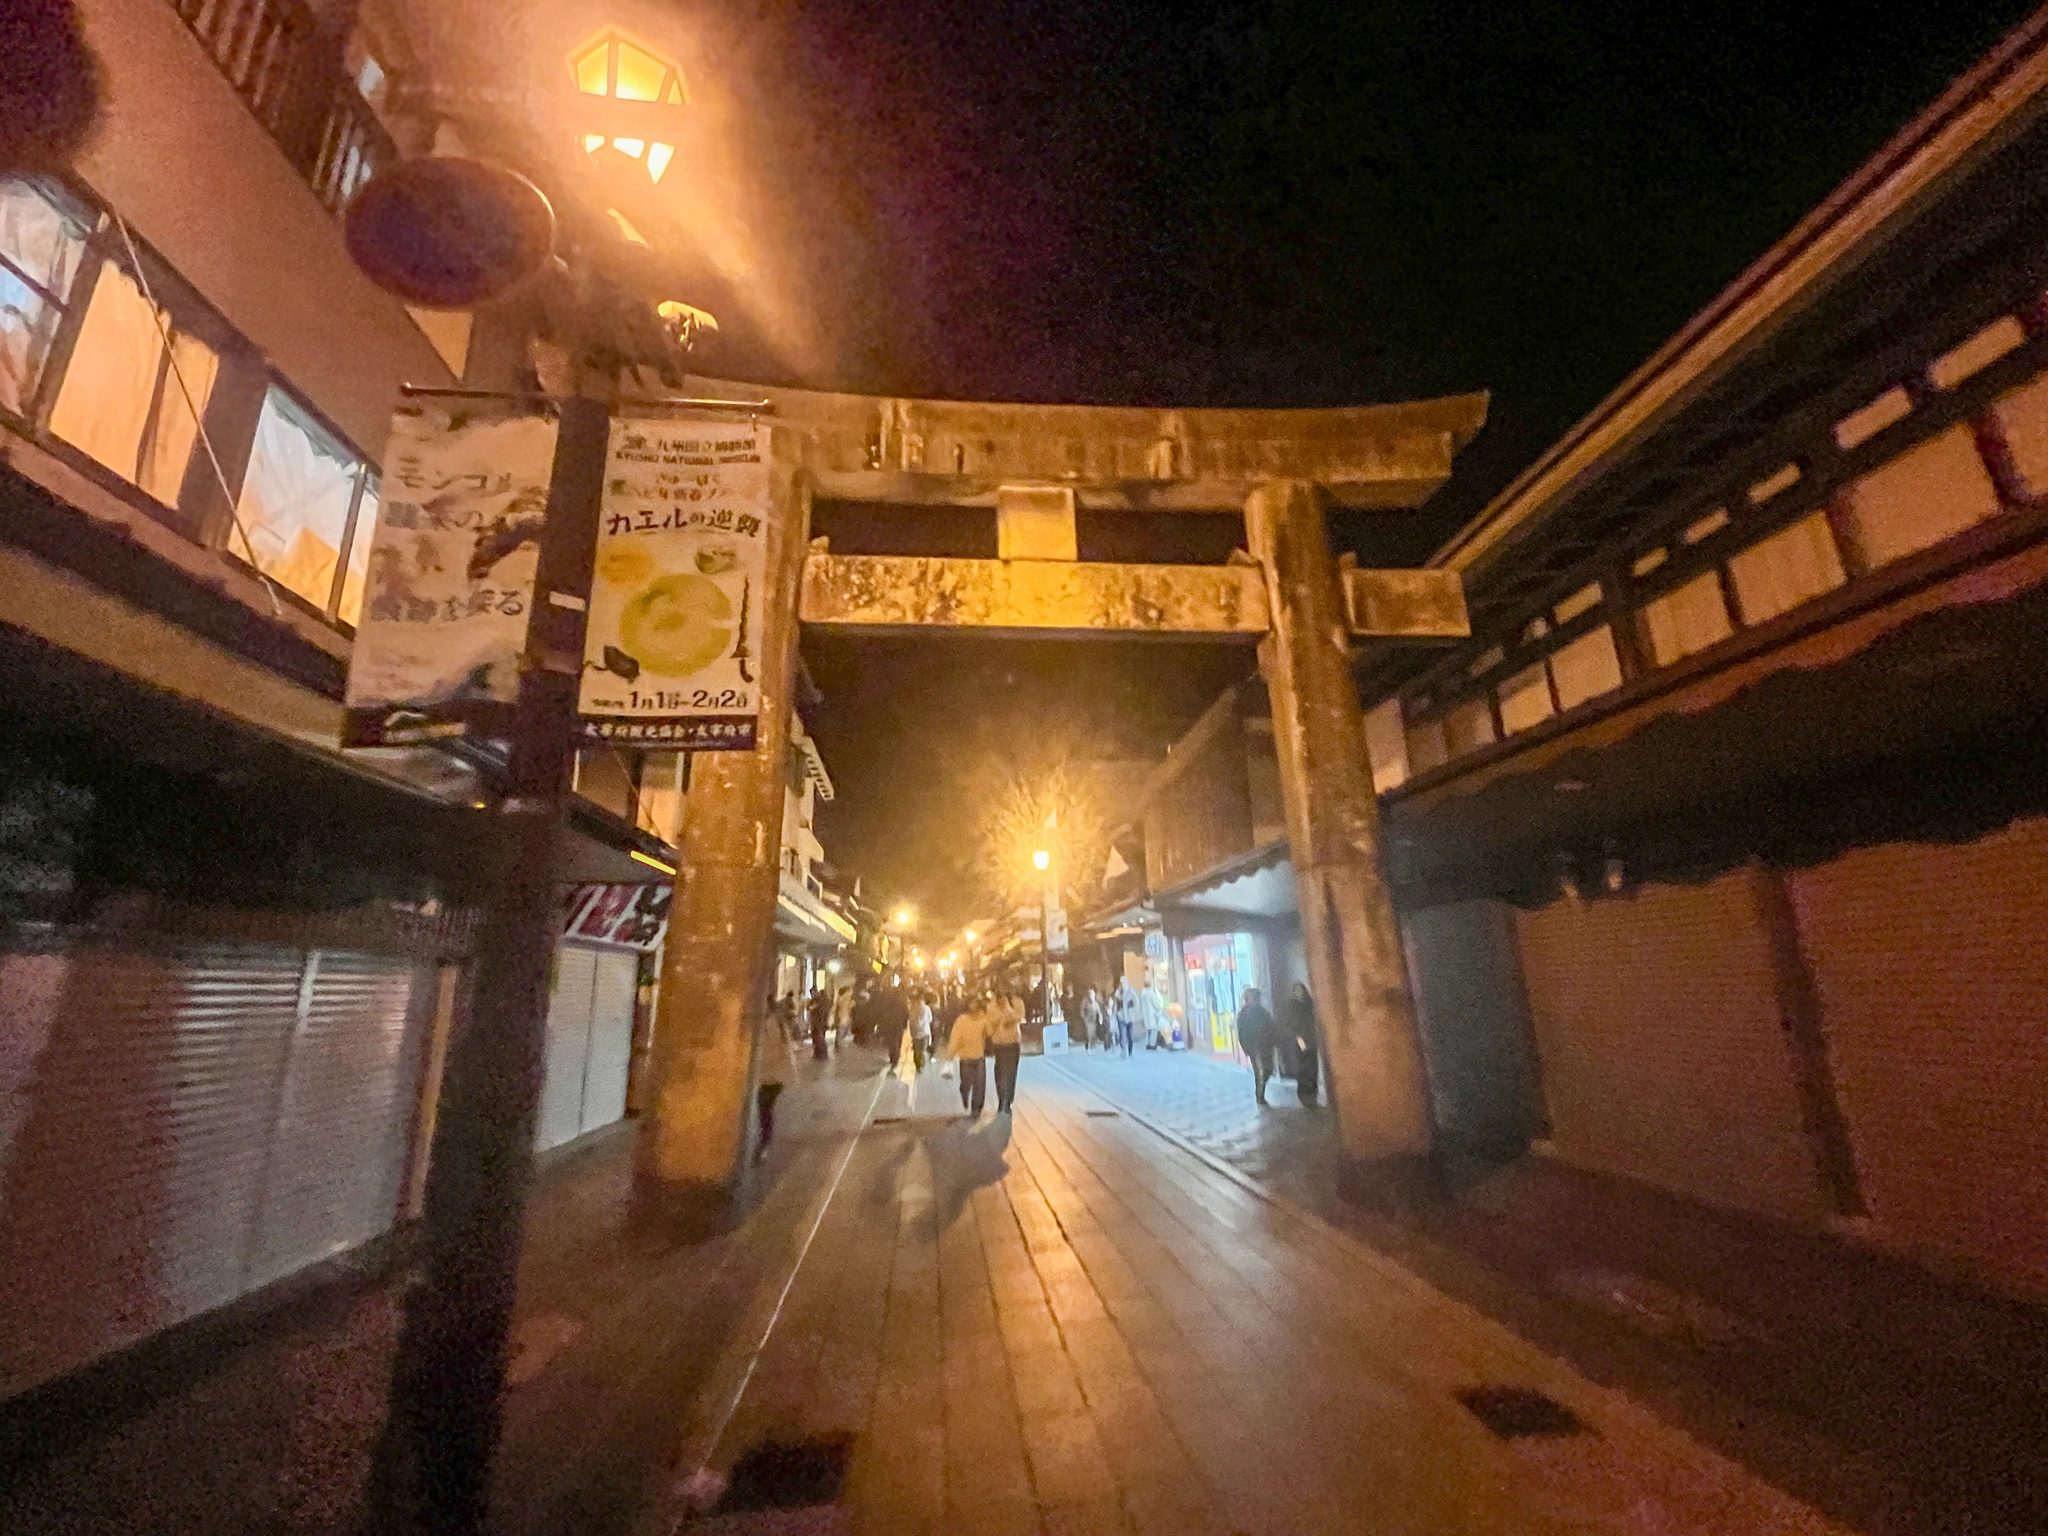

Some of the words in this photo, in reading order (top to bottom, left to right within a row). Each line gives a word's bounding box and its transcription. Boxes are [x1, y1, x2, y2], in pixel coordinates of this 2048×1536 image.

[606, 507, 762, 538] カエルの逆襲
